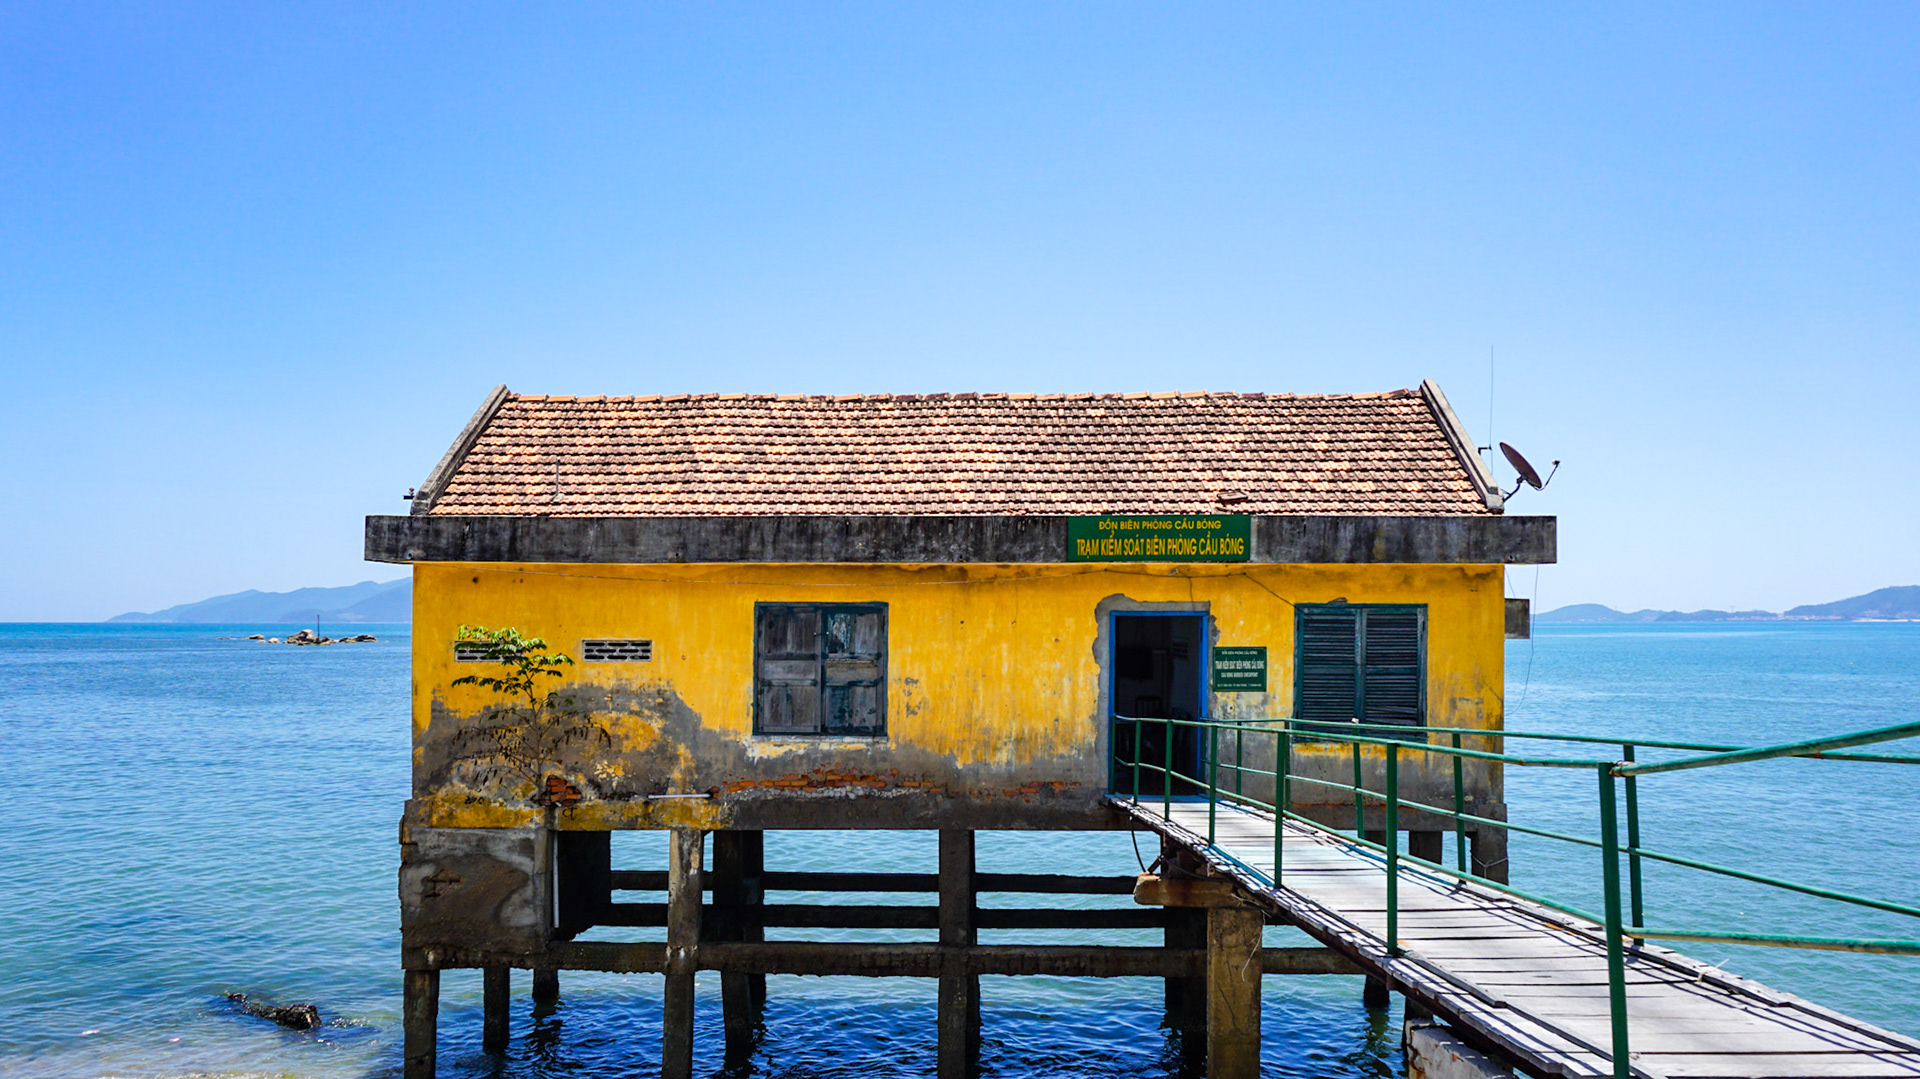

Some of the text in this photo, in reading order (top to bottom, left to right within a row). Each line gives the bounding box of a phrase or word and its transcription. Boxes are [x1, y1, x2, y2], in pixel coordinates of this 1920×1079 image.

[1120, 519, 1140, 530] BIÊN
[1142, 519, 1173, 530] PHÒNG
[1077, 539, 1099, 559] TRẠM
[1101, 531, 1122, 555] KIỂM
[1124, 534, 1145, 555] SOÁT
[1146, 534, 1165, 555] BIÊN
[1167, 534, 1197, 555] PHÒNG
[1220, 533, 1244, 555] BÓNG
